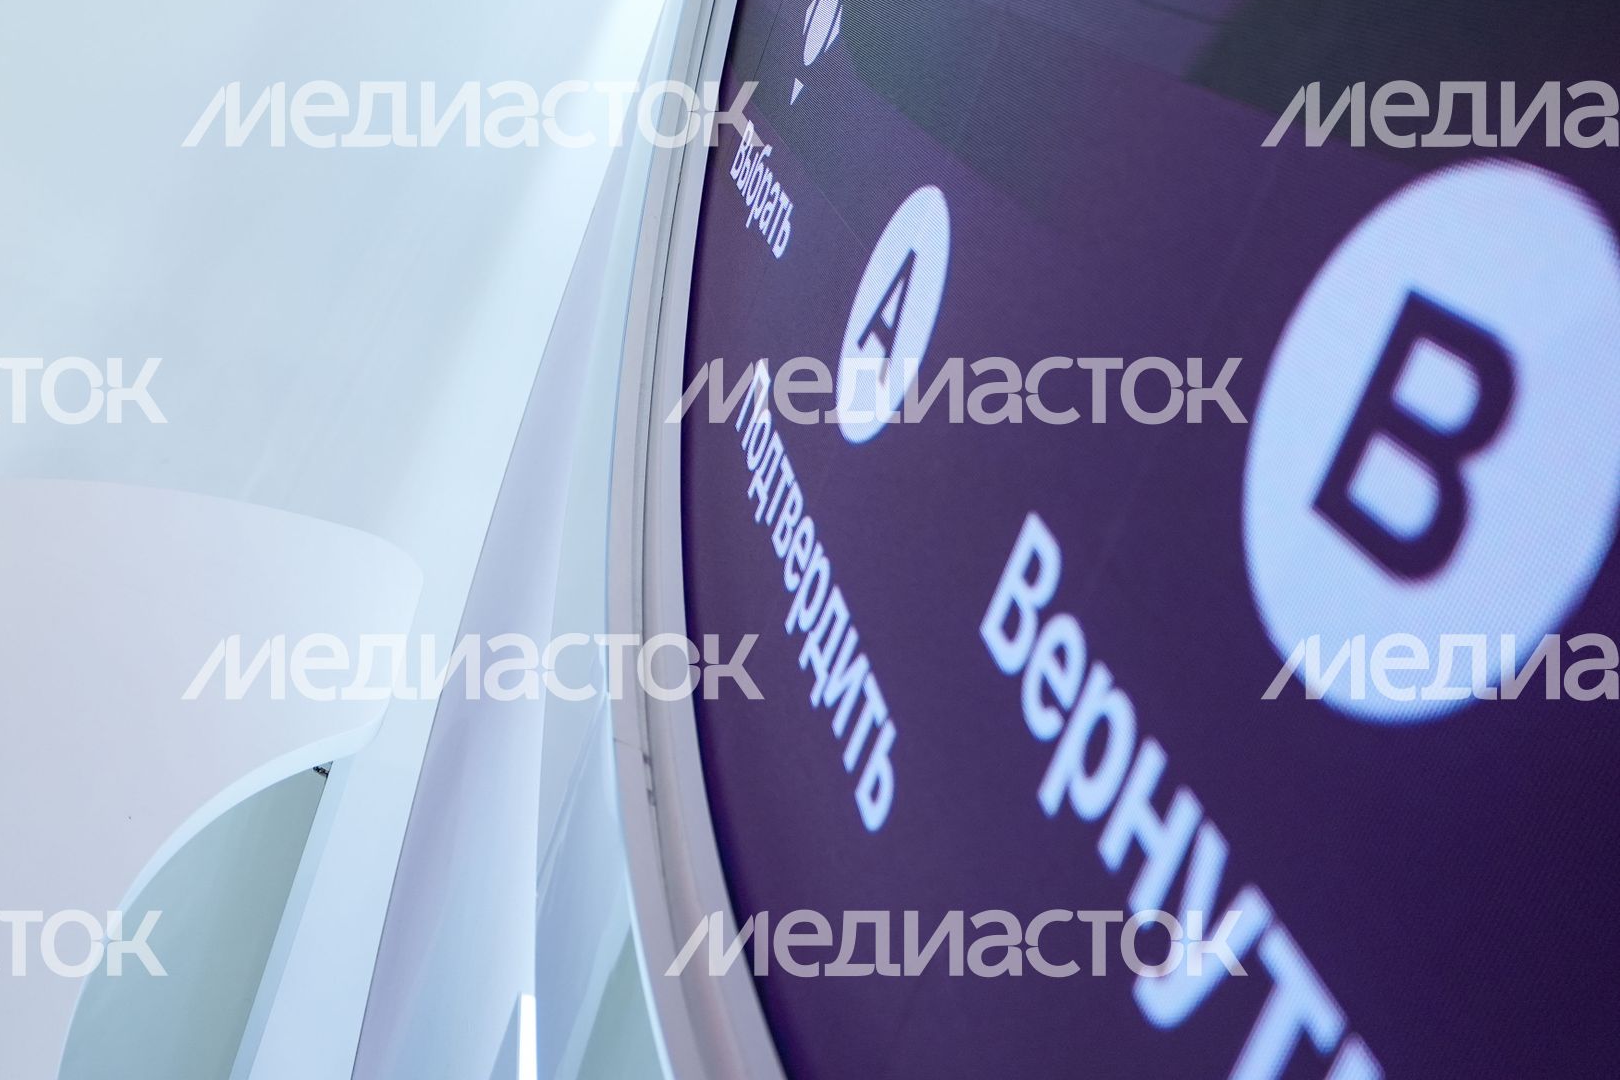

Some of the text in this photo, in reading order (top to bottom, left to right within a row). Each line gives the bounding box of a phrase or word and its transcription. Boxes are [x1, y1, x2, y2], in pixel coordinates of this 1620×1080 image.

[730, 119, 794, 259] Выбрать
[856, 246, 917, 387] A
[1312, 285, 1518, 584] B
[735, 358, 897, 832] Подтвердить
